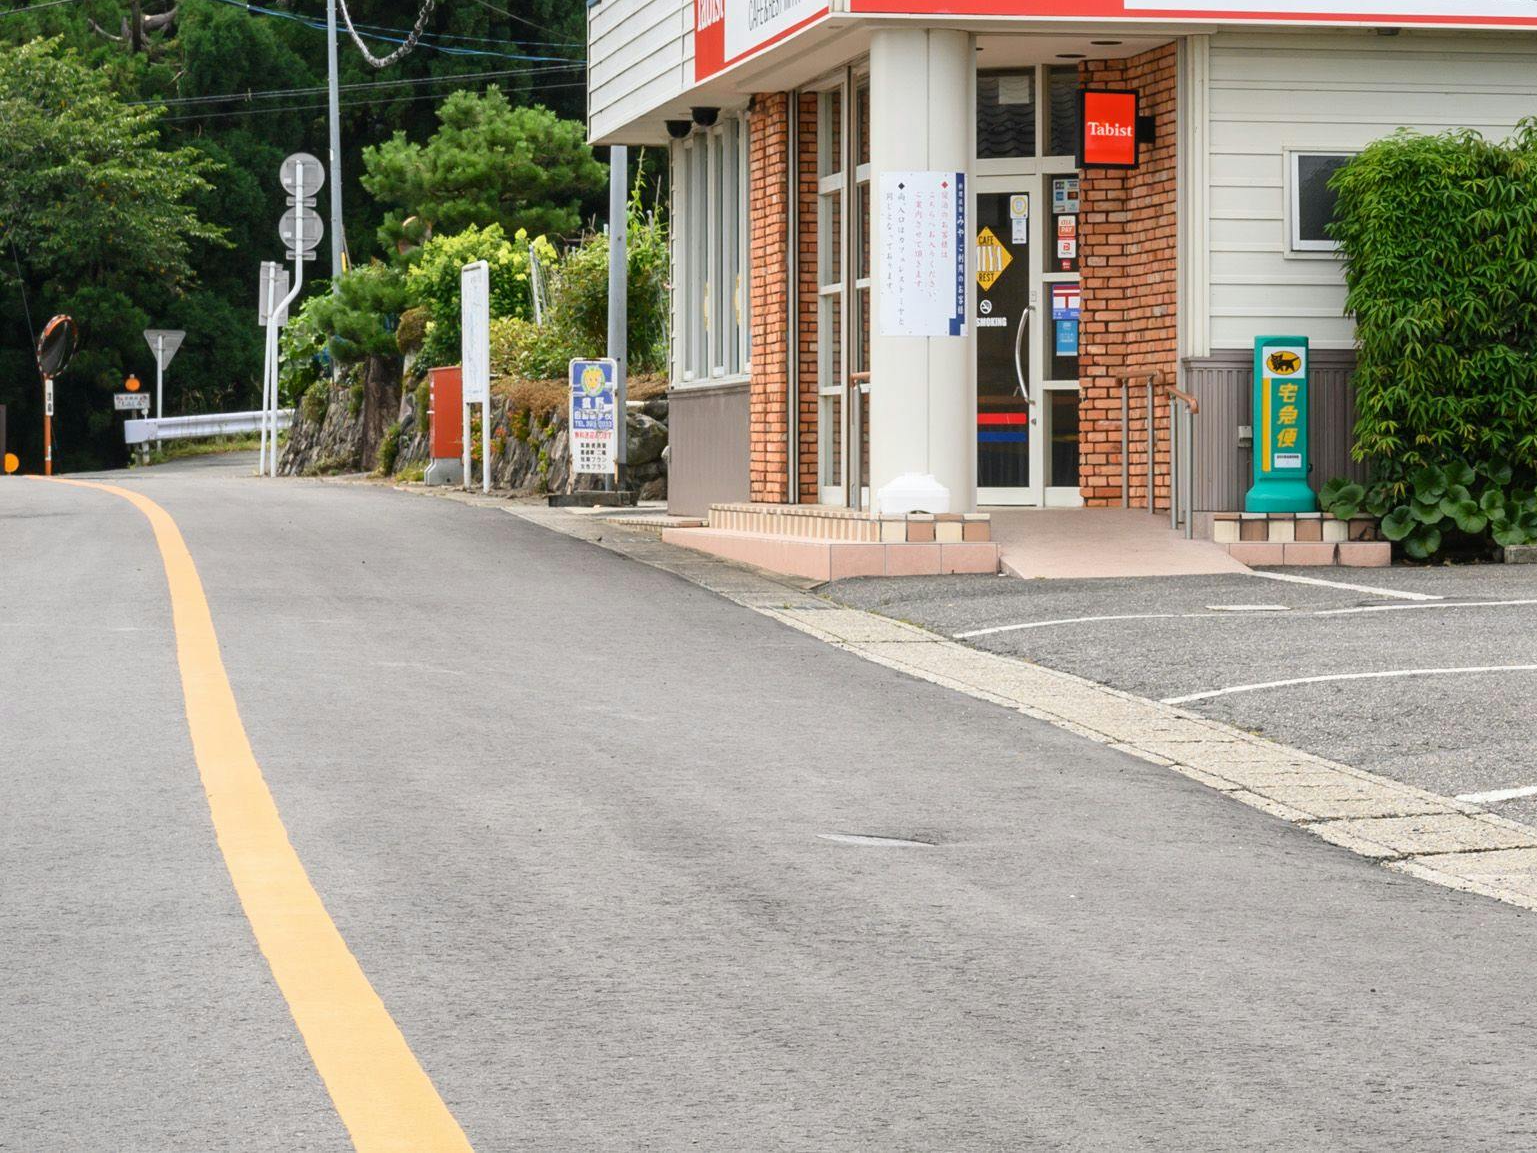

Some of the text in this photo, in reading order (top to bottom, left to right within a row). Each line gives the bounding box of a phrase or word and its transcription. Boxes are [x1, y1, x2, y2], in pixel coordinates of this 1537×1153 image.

[1087, 121, 1133, 137] Tabist
[978, 235, 994, 245] CAFE
[979, 273, 994, 282] REST
[976, 317, 1008, 327] SMOKING
[1276, 382, 1299, 448] 宅急便
